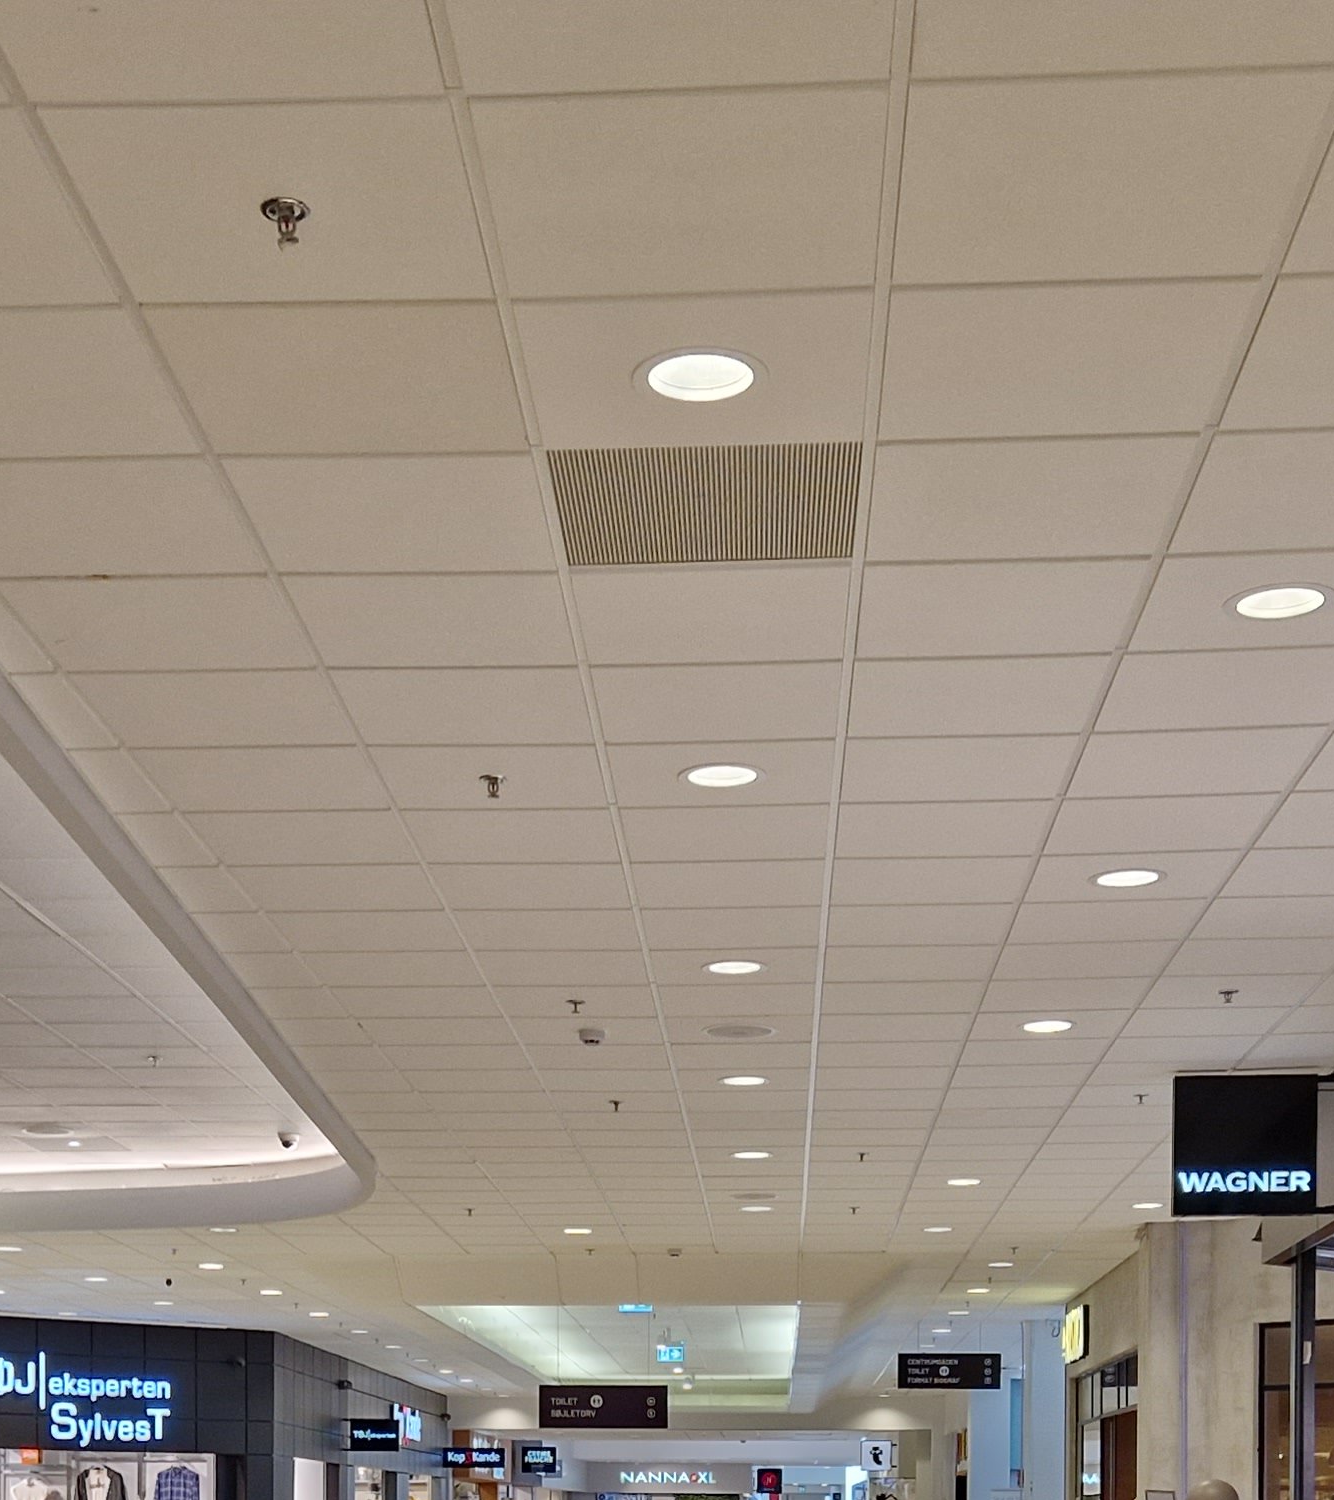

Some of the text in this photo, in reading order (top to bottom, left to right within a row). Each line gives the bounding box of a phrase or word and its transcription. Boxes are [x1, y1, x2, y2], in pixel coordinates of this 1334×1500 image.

[1178, 1170, 1312, 1193] WAGNER
[48, 1372, 172, 1402] eksperten
[550, 1397, 578, 1406] TOILET
[50, 1401, 172, 1448] SylvesT
[447, 1451, 465, 1464] Kop
[472, 1451, 501, 1463] Kande
[620, 1471, 716, 1484] NANNA XL
